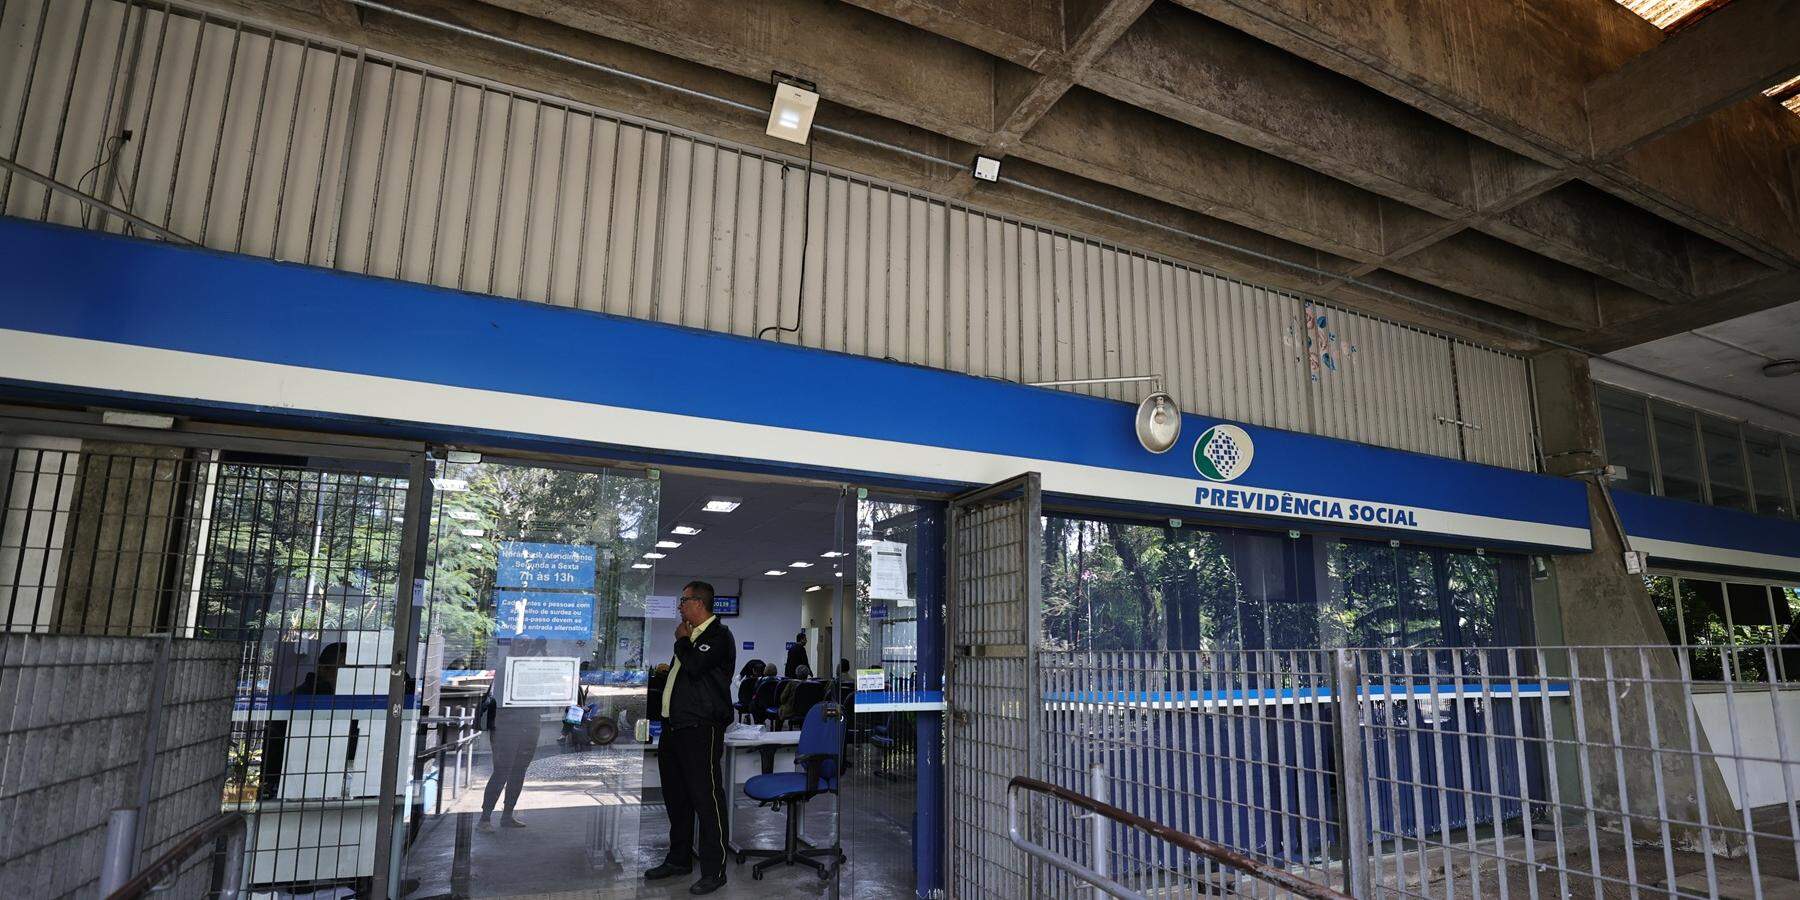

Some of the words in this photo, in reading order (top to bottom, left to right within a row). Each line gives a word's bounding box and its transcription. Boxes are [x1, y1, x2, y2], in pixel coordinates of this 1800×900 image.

[1195, 487, 1344, 519] PREVIDÊNCIA
[1349, 504, 1418, 527] SOCIAL
[502, 550, 530, 559] Horáro
[544, 552, 593, 561] Atendimnto
[558, 562, 579, 570] Sexta
[520, 571, 533, 581] 7h
[554, 572, 574, 582] 13h
[502, 599, 541, 607] Cadntes
[510, 608, 539, 616] apelho
